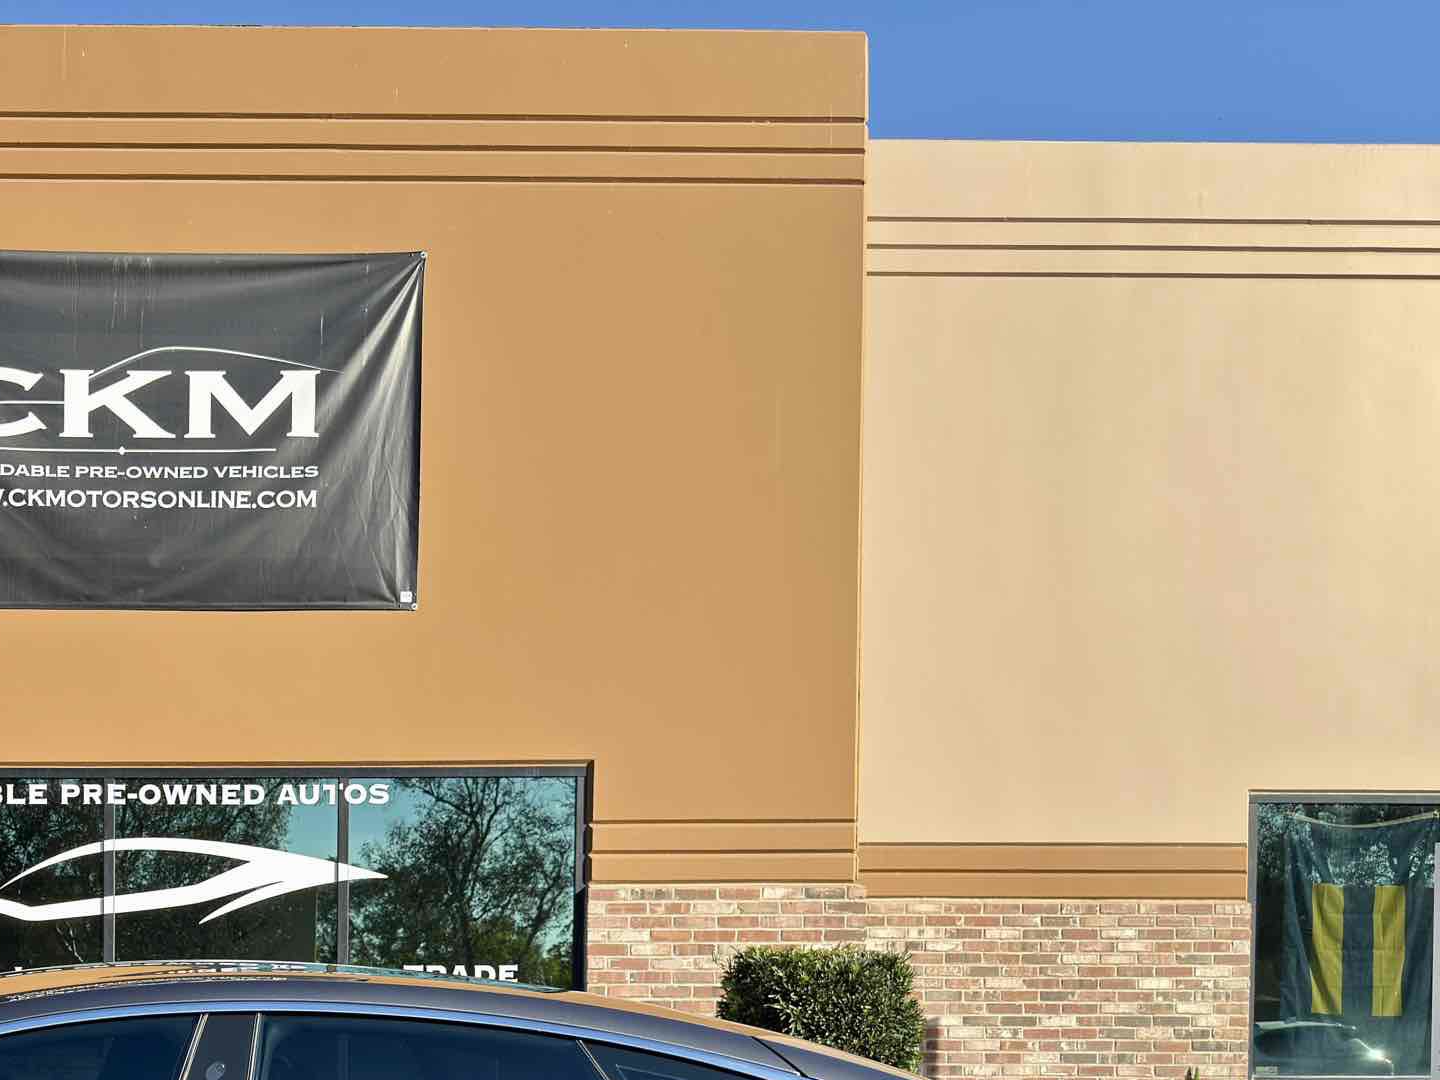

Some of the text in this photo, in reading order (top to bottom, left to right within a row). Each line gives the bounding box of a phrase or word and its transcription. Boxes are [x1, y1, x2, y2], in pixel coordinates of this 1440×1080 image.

[74, 465, 209, 479] PRE-OWNED
[213, 465, 320, 479] VEHICLES
[60, 783, 264, 805] PRE-OWNED
[276, 783, 391, 806] AUTOS
